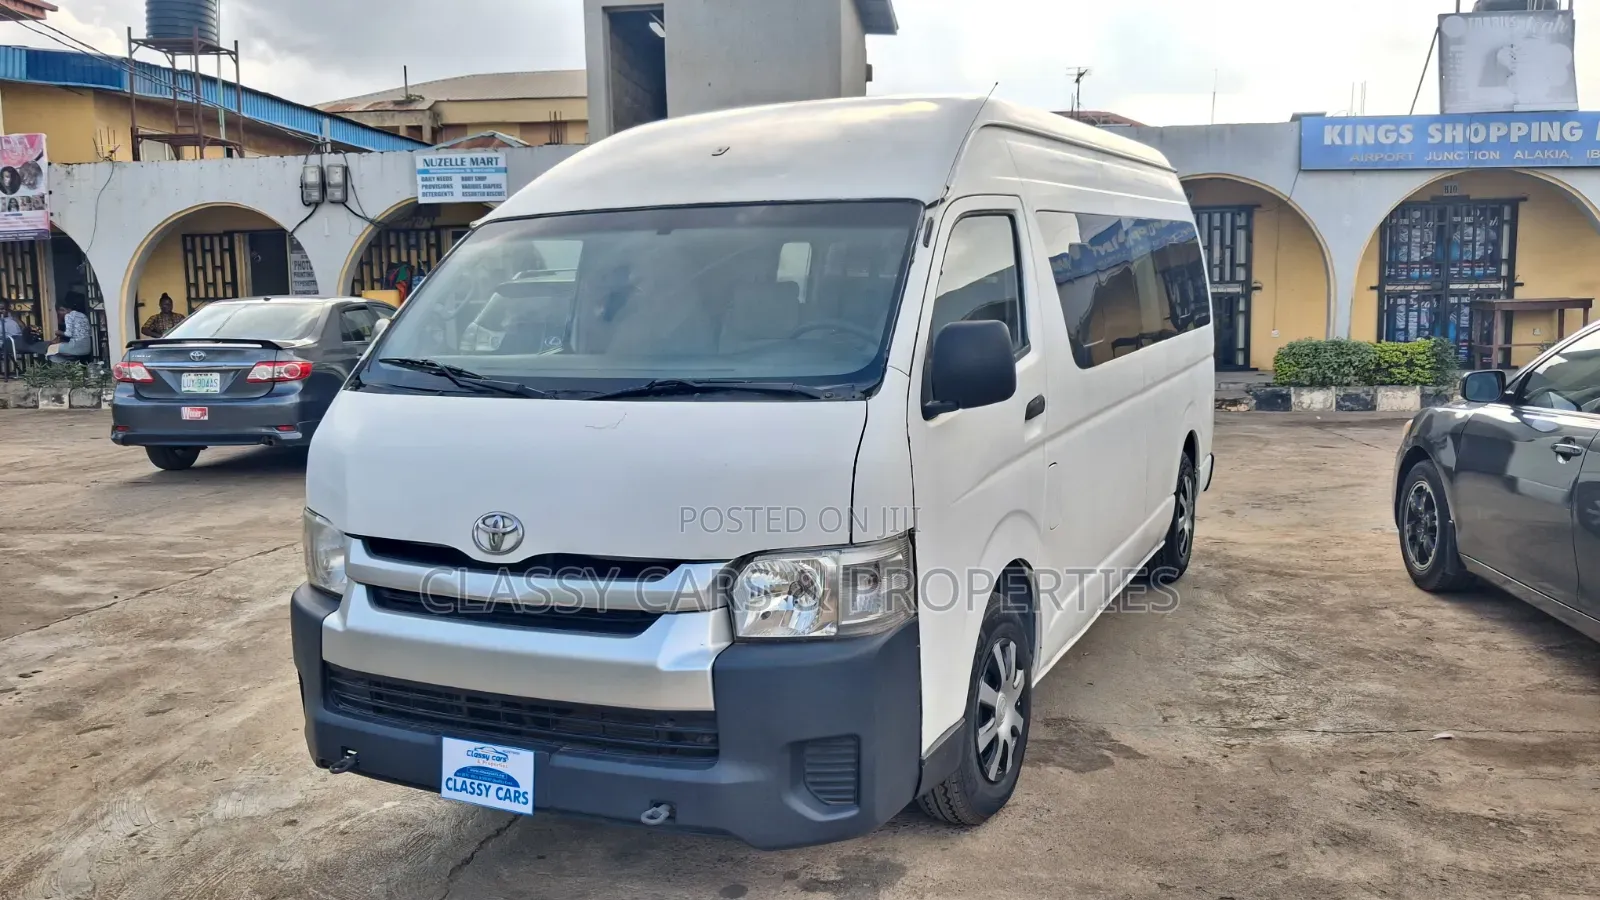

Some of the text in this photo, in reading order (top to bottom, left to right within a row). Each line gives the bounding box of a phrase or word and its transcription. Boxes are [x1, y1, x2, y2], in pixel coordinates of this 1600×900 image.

[1323, 124, 1414, 146] KINGS
[1427, 121, 1583, 144] SHOPPING
[423, 156, 500, 168] NUZELLE MART
[1350, 152, 1414, 163] AIRPORT
[1424, 150, 1500, 162] JUNCTION
[466, 749, 508, 763] Classy cars
[445, 777, 492, 798] CLASSY
[495, 786, 529, 806] CARS
